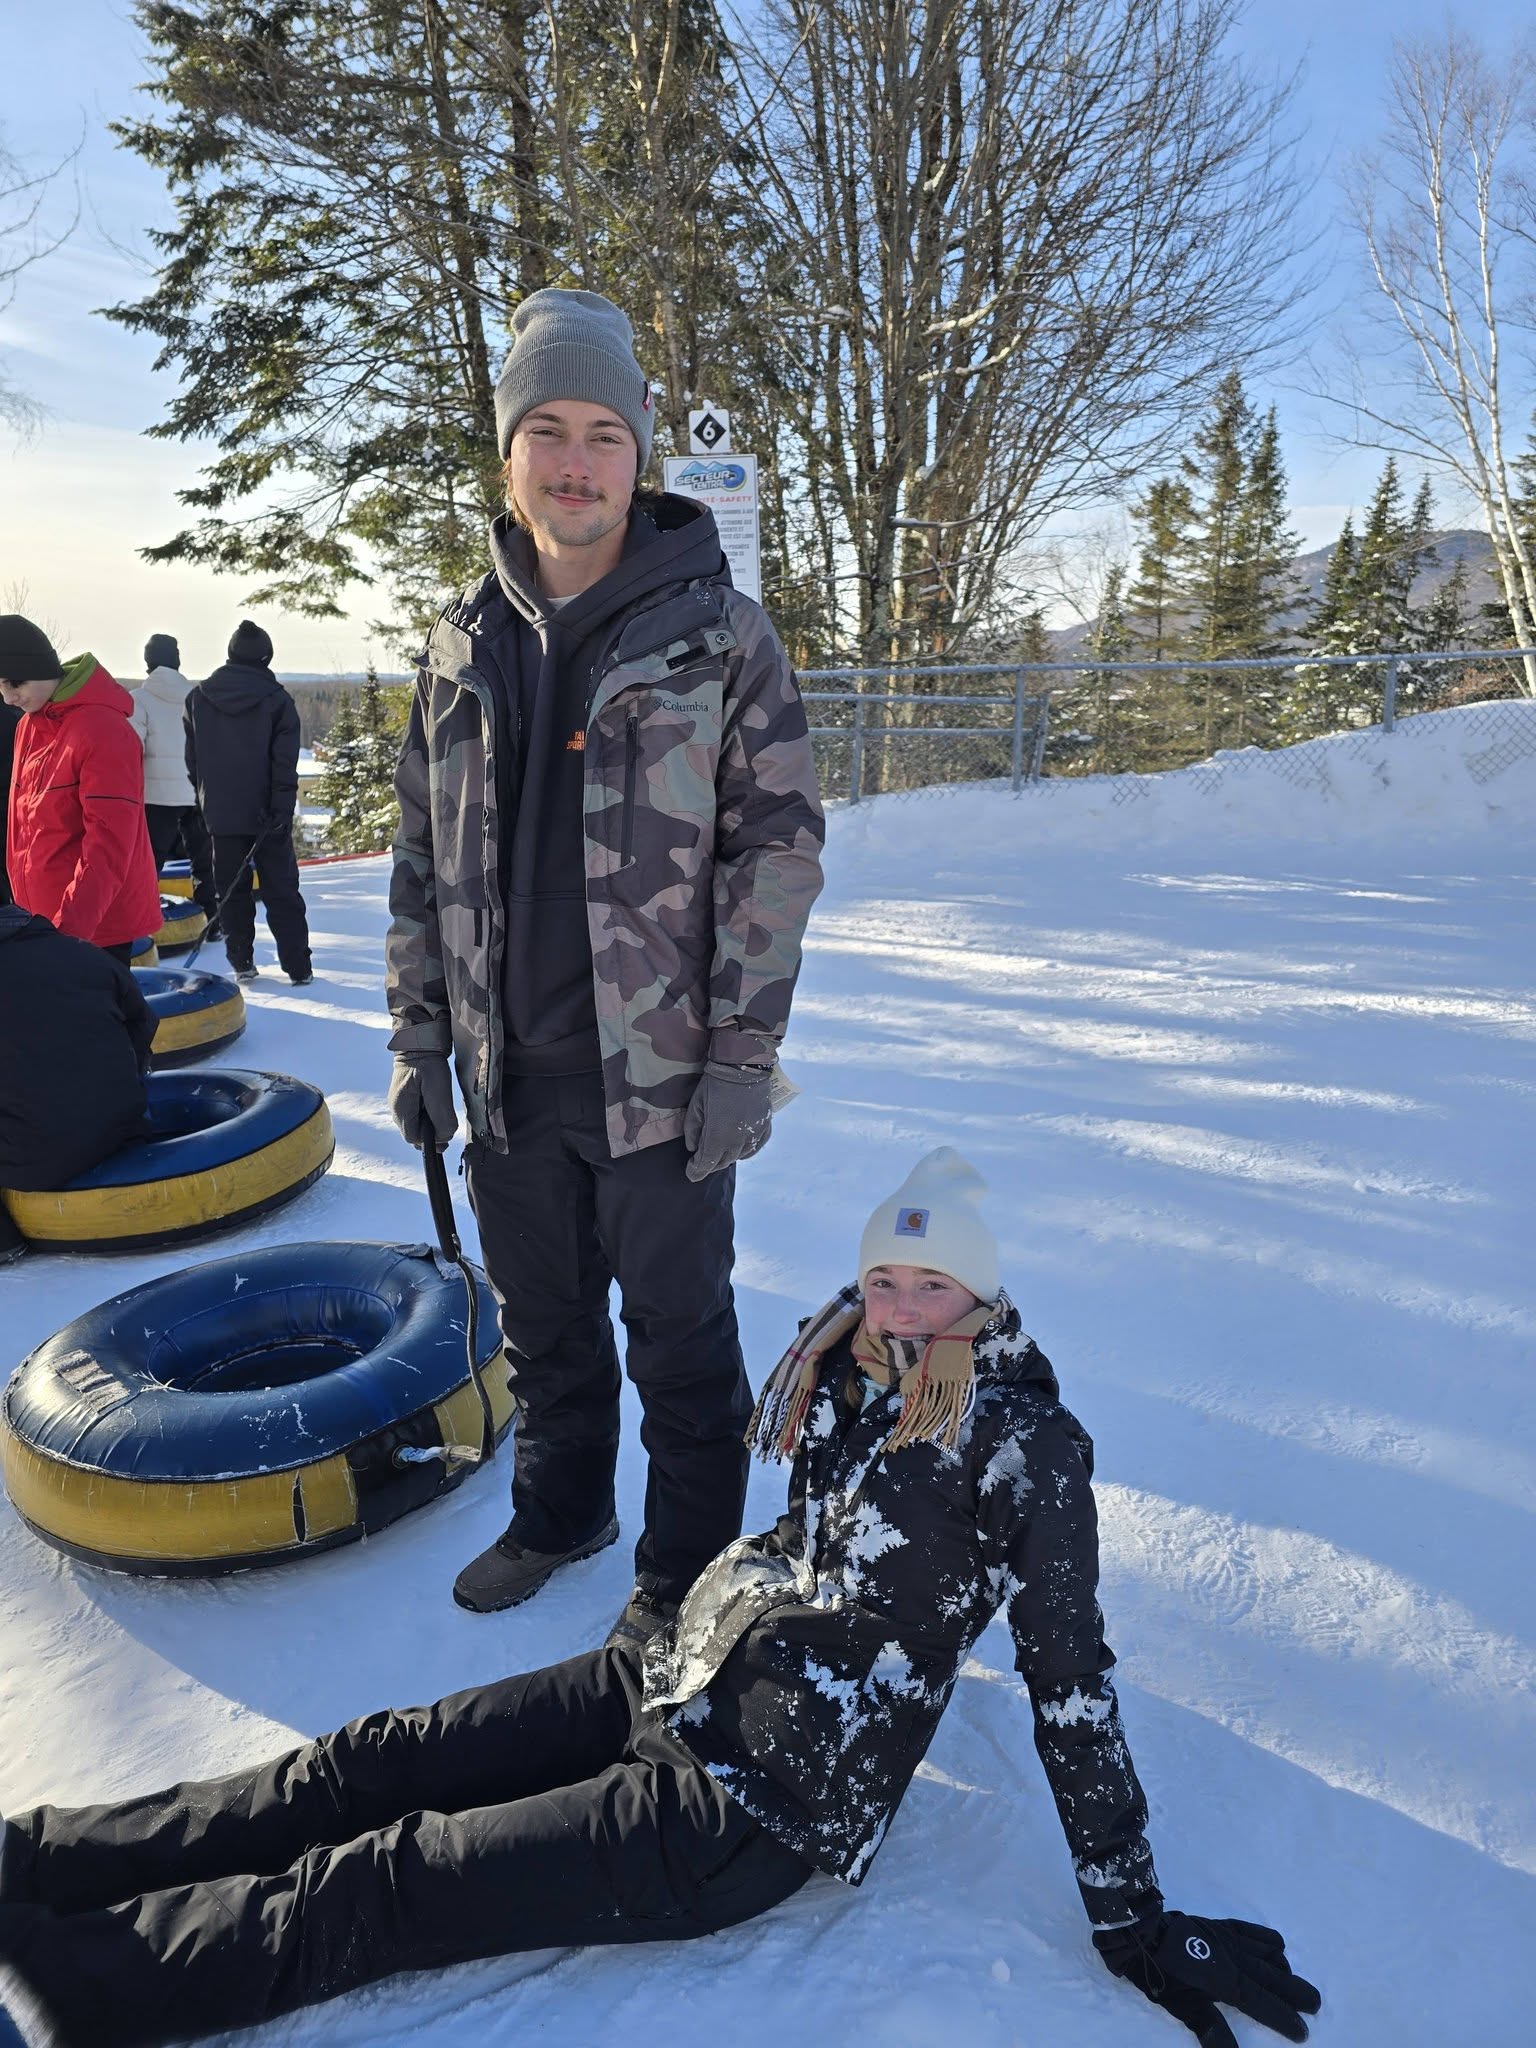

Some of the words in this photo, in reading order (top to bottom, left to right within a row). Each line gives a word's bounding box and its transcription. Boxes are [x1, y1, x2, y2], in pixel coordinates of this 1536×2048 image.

[702, 421, 716, 441] 6
[675, 470, 730, 485] SECTEUR
[692, 479, 727, 491] CENTRAL
[662, 700, 709, 712] Columbia
